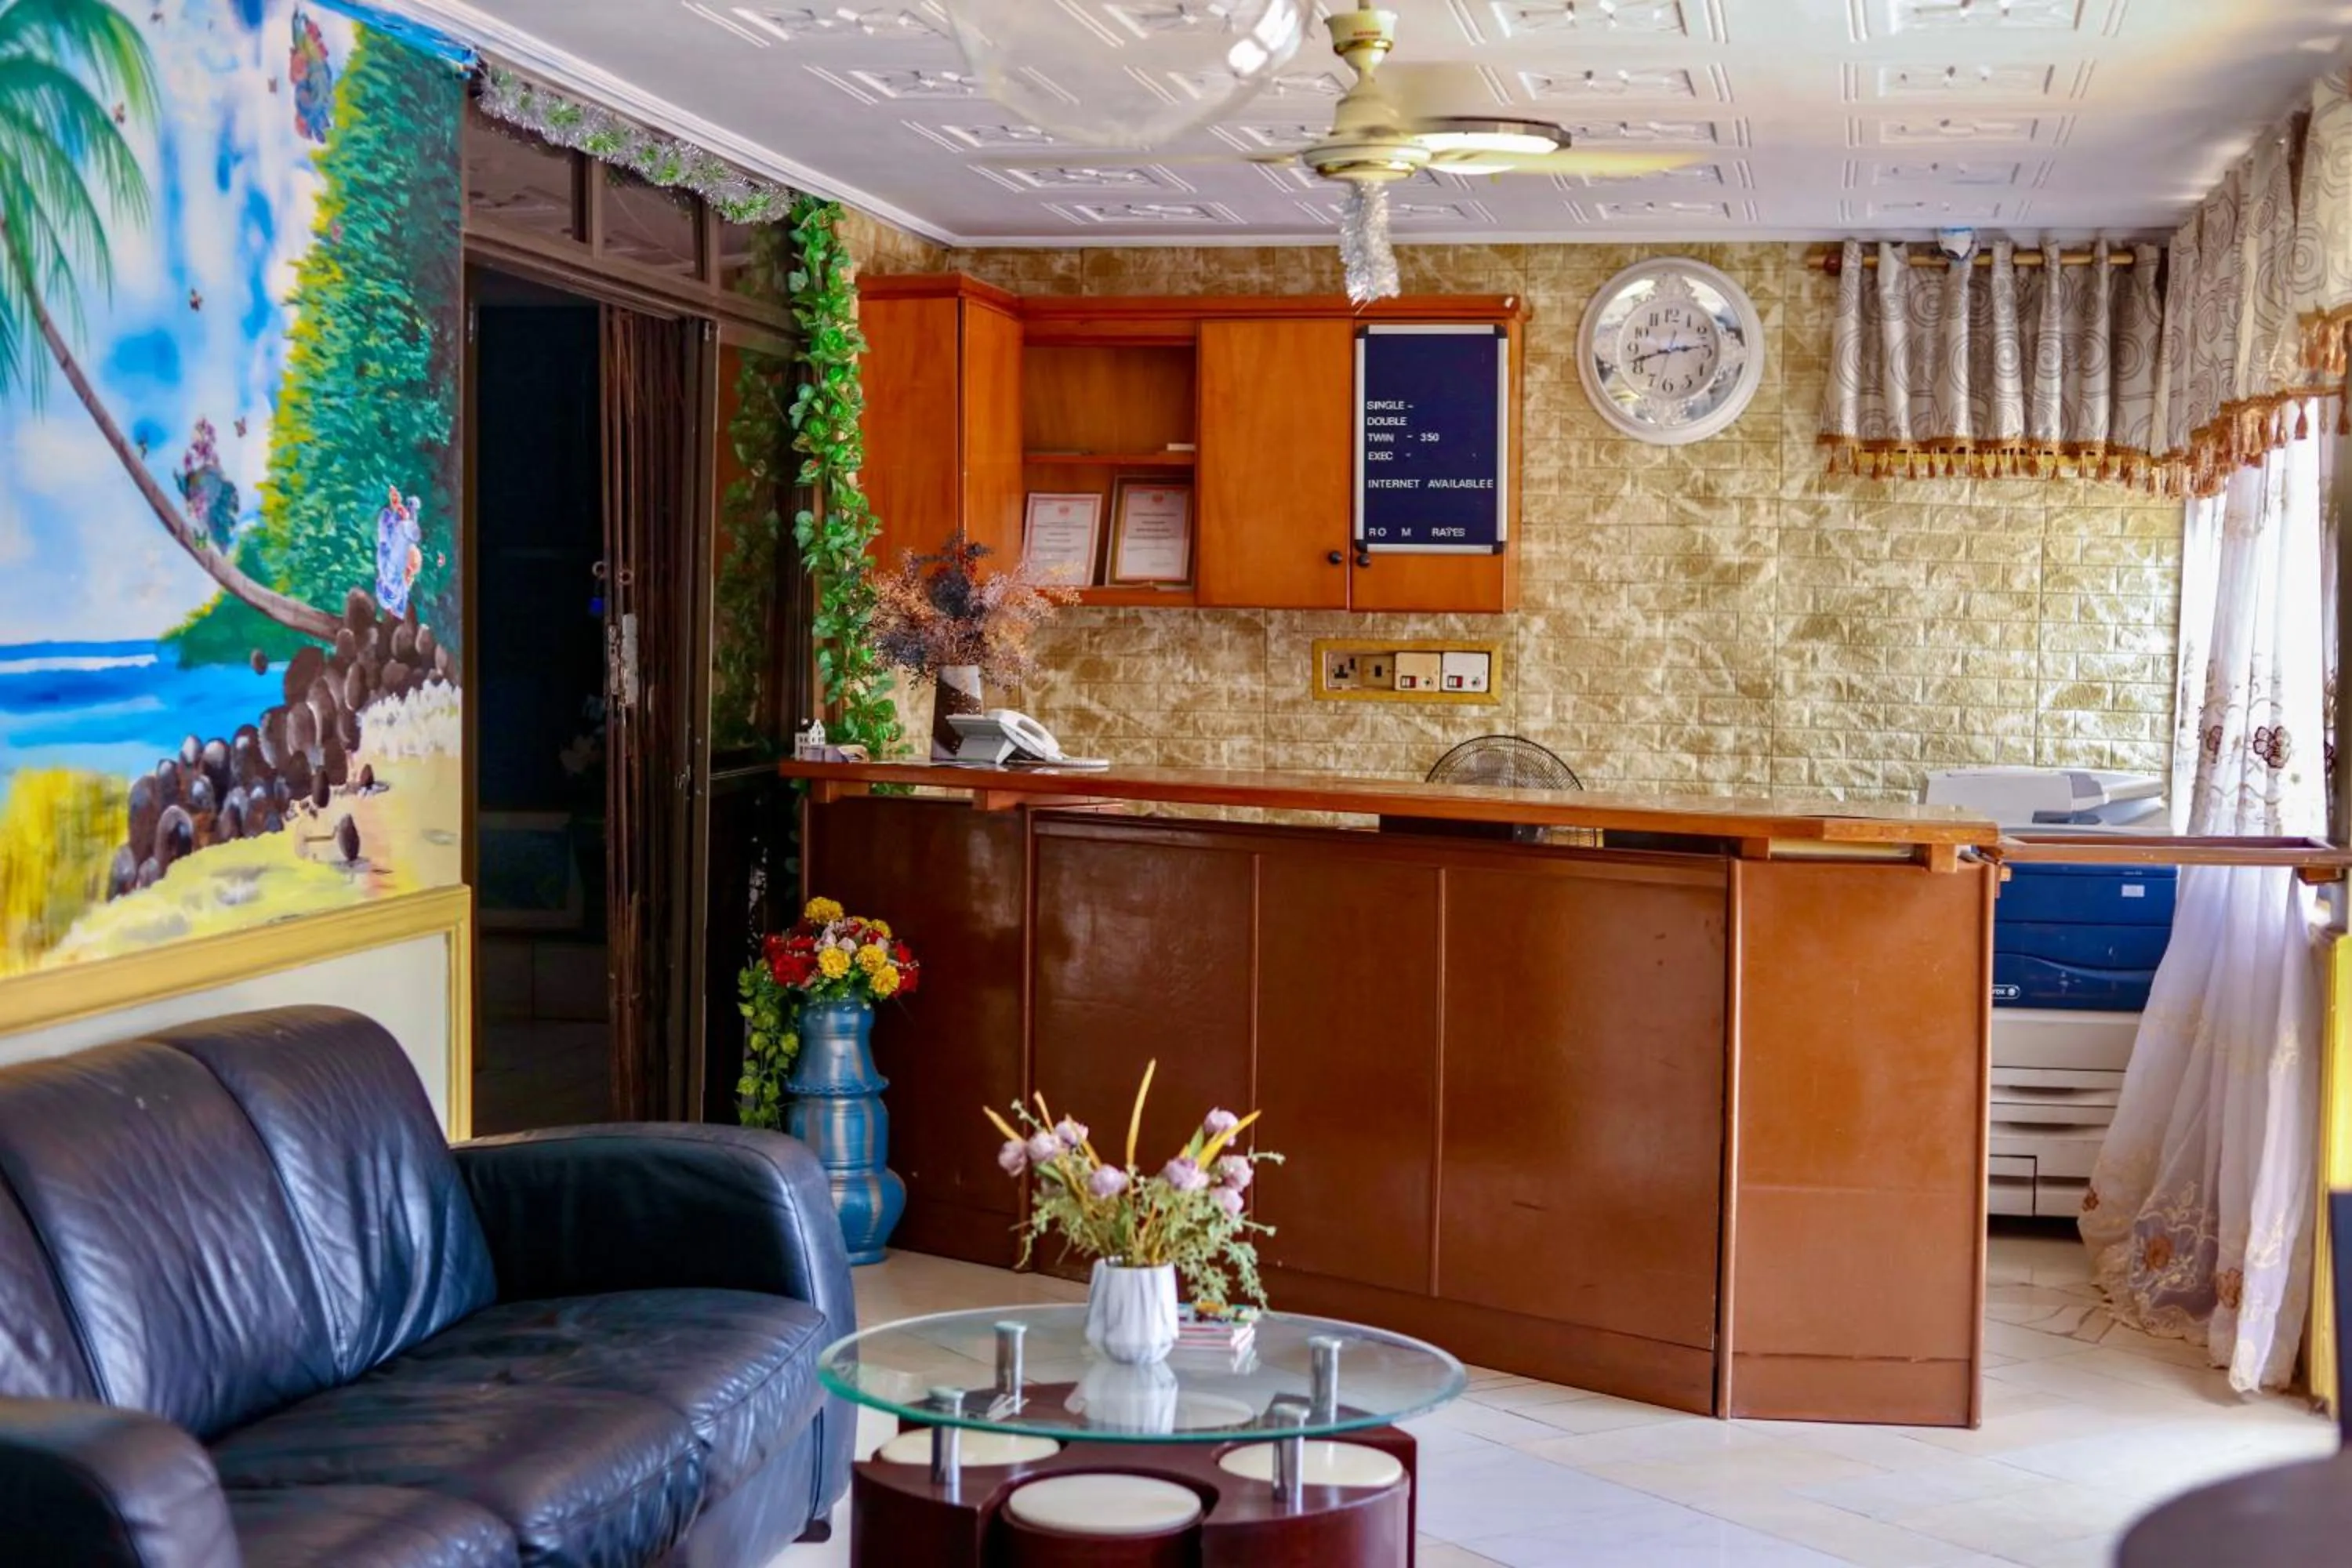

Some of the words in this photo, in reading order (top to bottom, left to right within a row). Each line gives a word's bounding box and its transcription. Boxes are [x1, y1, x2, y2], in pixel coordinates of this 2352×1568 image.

[1650, 313, 1659, 326] 11
[1664, 307, 1680, 324] 12
[1627, 341, 1639, 355] 9
[1662, 377, 1674, 393] 6
[1367, 401, 1405, 410] SINGLE
[1367, 416, 1407, 426] DOUBLE
[1367, 432, 1395, 443] TWIN
[1420, 432, 1439, 441] 350
[1368, 451, 1393, 460] EXEC
[1367, 479, 1421, 488] INTERNET
[1432, 527, 1465, 537] RATES
